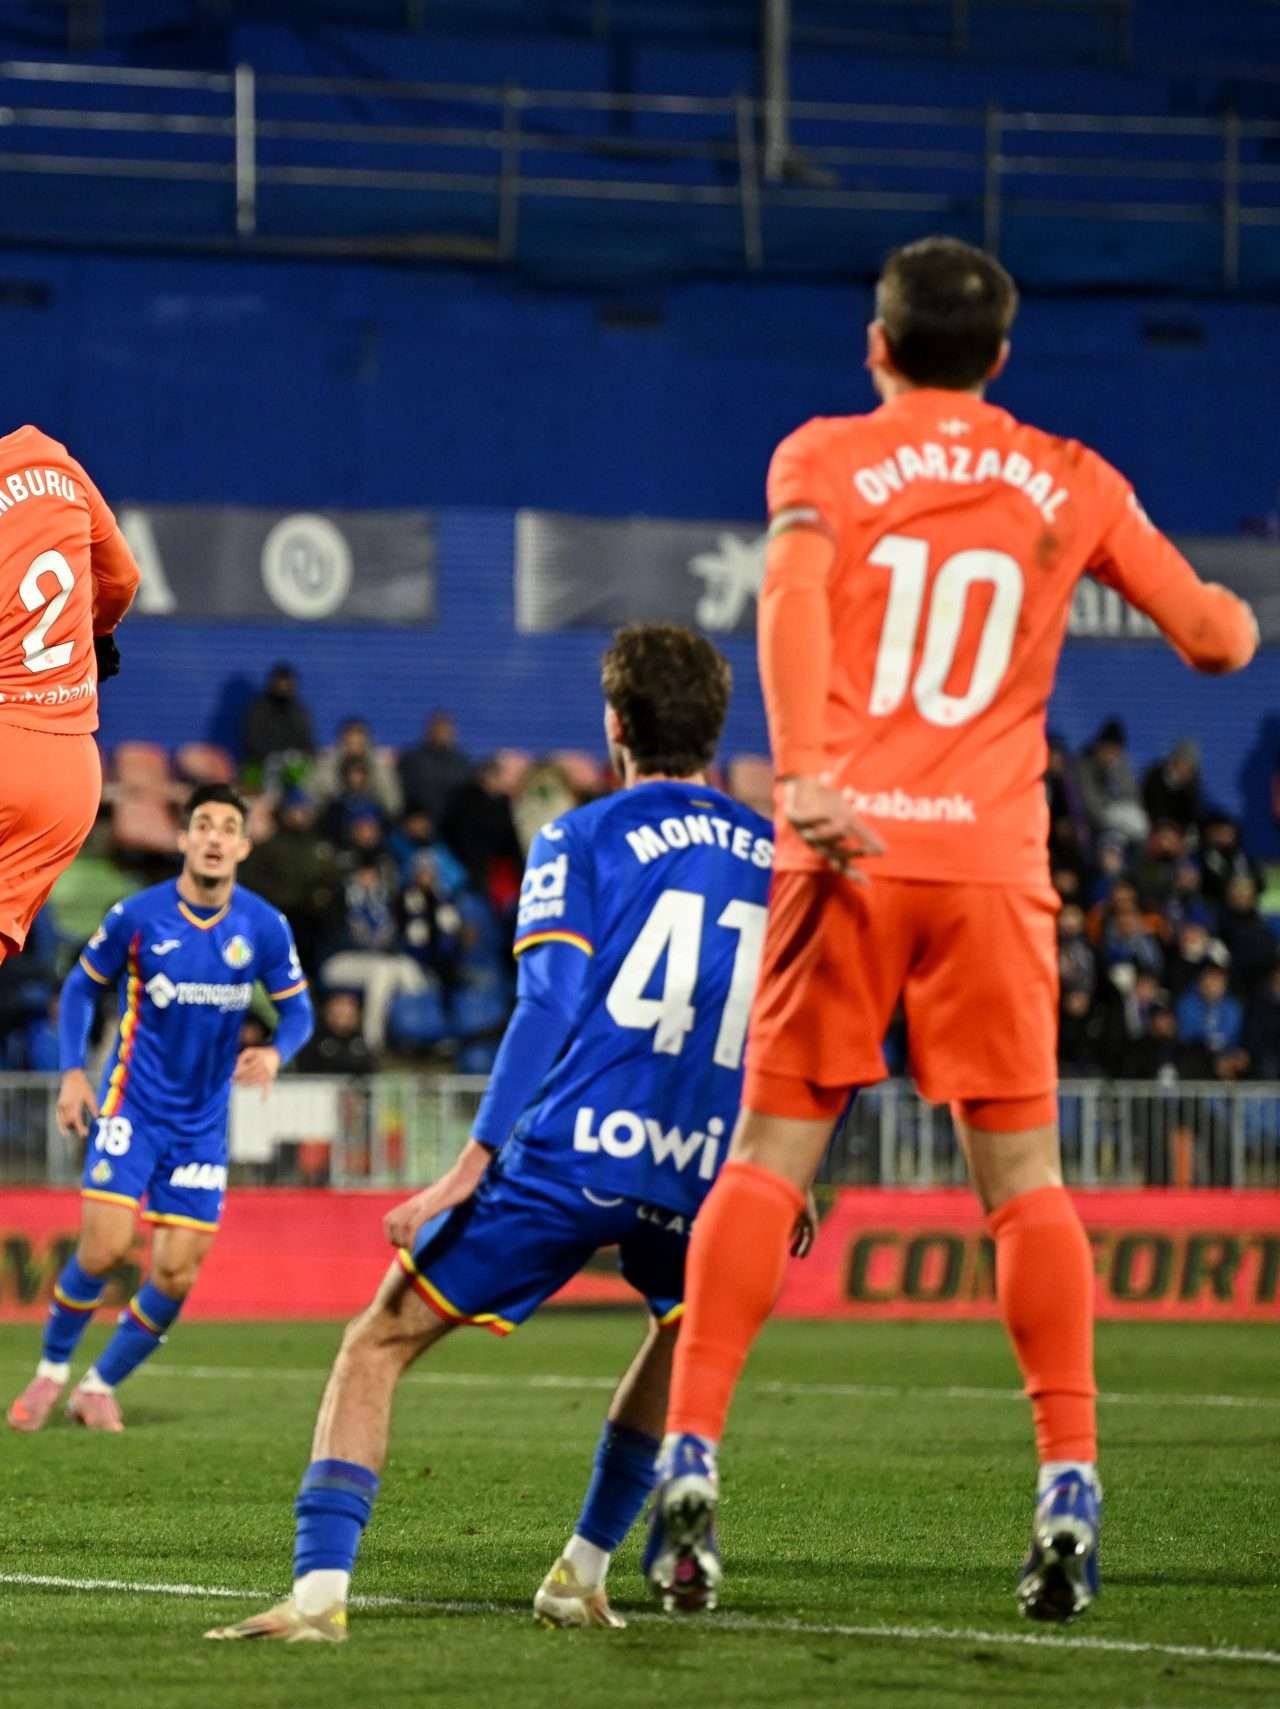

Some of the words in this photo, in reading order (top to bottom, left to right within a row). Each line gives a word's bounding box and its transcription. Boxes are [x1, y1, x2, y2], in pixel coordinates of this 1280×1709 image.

[18, 549, 75, 673] 2
[867, 534, 1025, 726] 10
[625, 814, 775, 869] MONTES
[606, 889, 769, 1071] 41
[95, 1116, 133, 1156] 18
